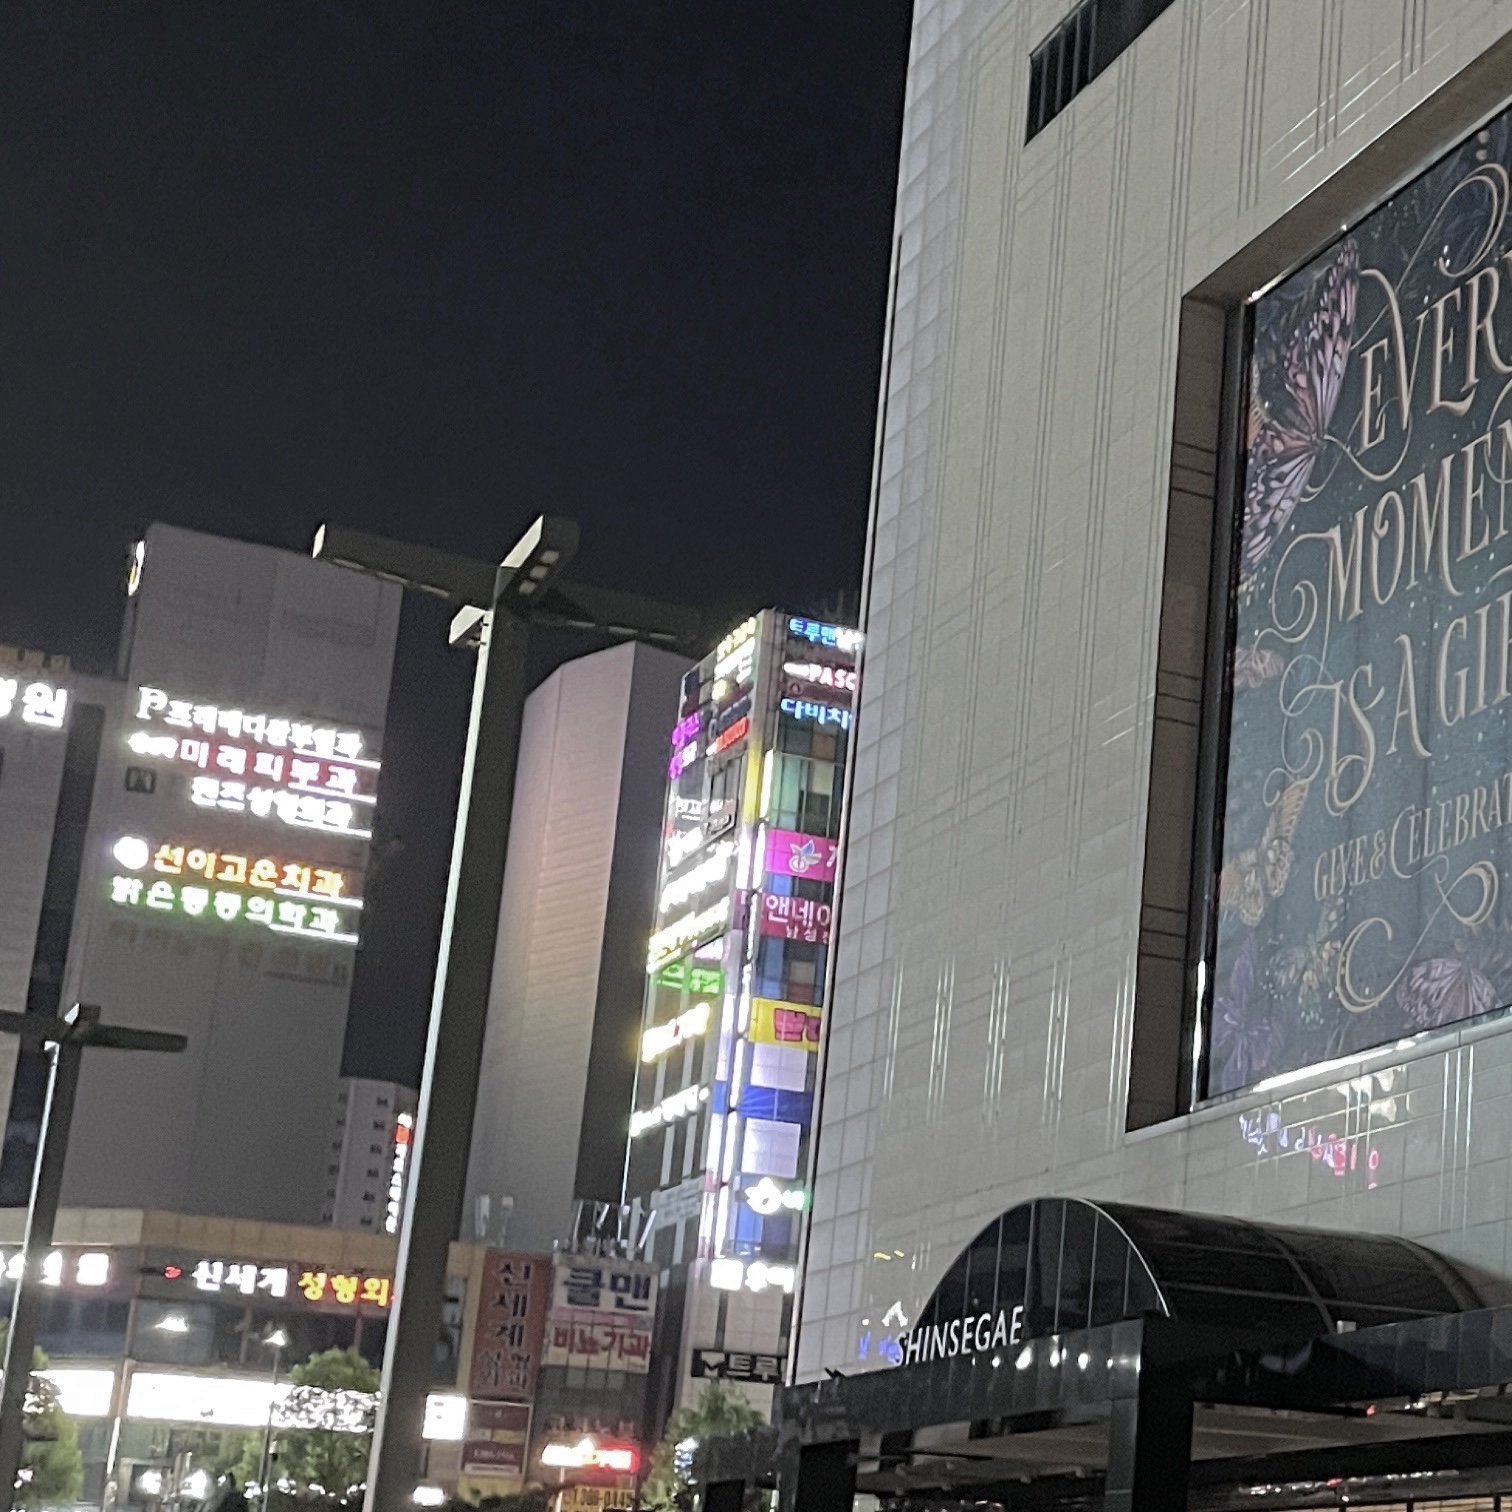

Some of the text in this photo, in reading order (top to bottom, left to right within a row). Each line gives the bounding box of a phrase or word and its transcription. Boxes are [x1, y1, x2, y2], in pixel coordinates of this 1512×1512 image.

[780, 696, 852, 729] 다비치
[1281, 658, 1386, 816] IS
[1385, 633, 1433, 758] A
[153, 843, 345, 898] 선이고운치과
[1314, 833, 1368, 901] GIVE
[297, 1270, 396, 1308] 성형외
[552, 1326, 650, 1361] 비뇨기과
[895, 1304, 1024, 1367] SHINSEGAE
[726, 1353, 788, 1384] 트루
